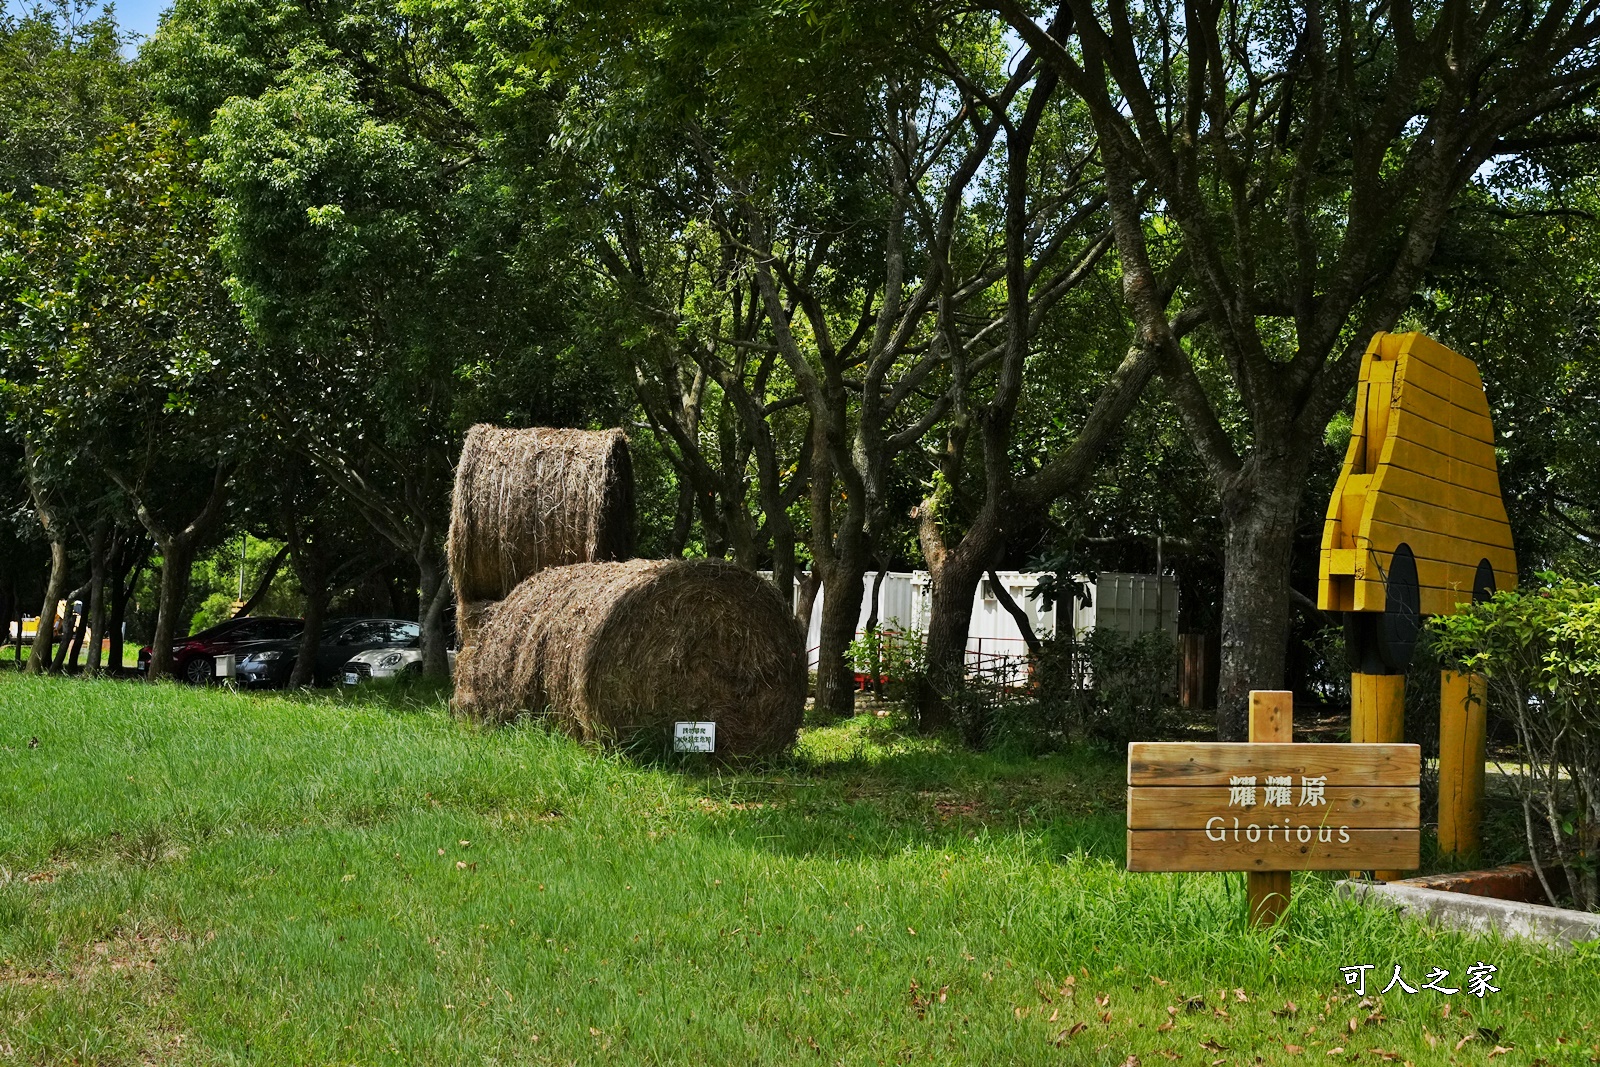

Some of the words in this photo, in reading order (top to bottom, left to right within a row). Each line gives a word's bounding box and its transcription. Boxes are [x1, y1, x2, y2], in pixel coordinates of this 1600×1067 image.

[1228, 775, 1328, 807] 耀耀原
[1205, 816, 1351, 844] Glorious
